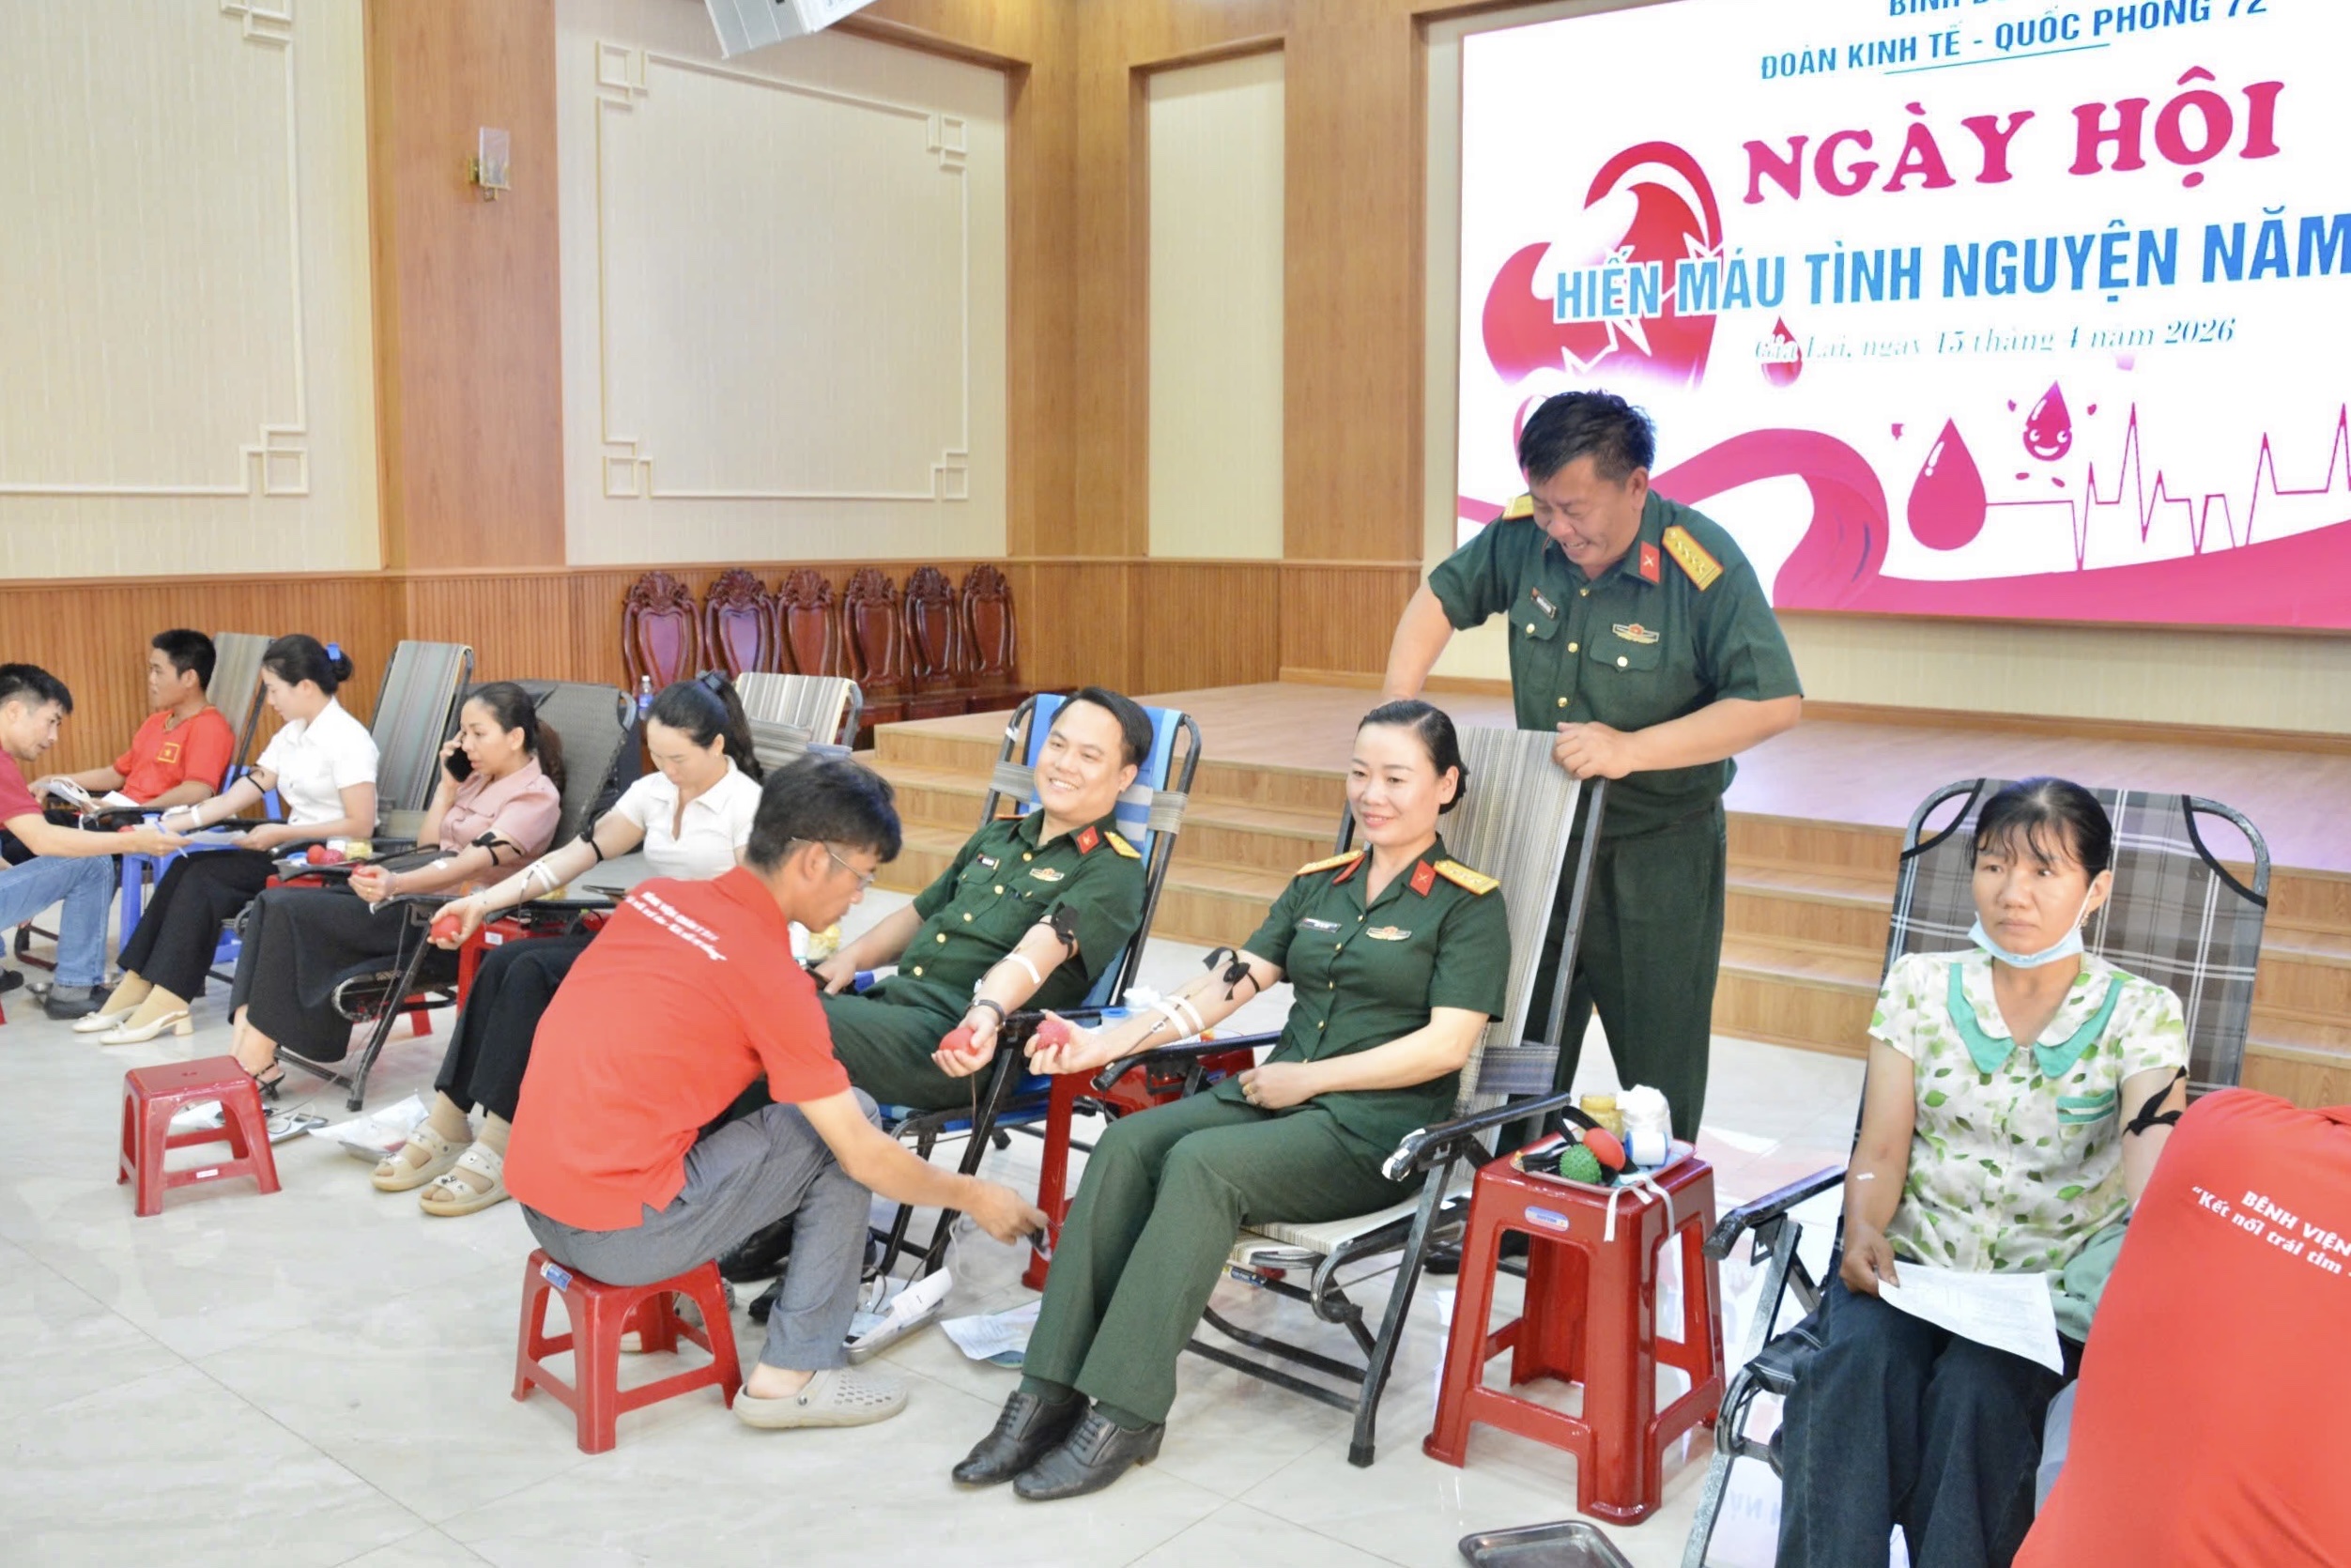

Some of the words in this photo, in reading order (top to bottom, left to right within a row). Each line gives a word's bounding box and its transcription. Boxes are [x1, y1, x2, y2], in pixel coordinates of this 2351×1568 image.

[1848, 37, 1916, 69] KINH
[1743, 101, 2036, 205] NGÀY
[2068, 66, 2284, 188] HỘI
[1556, 246, 1660, 320] HIẾN
[1678, 247, 1785, 313] MÁU
[1805, 240, 1922, 304] TÌNH
[1943, 219, 2178, 302] NGUYỆN
[2202, 206, 2351, 284] NĂM
[2164, 317, 2236, 345] 2026
[2266, 1231, 2305, 1256] trái
[2307, 1251, 2343, 1274] tim
